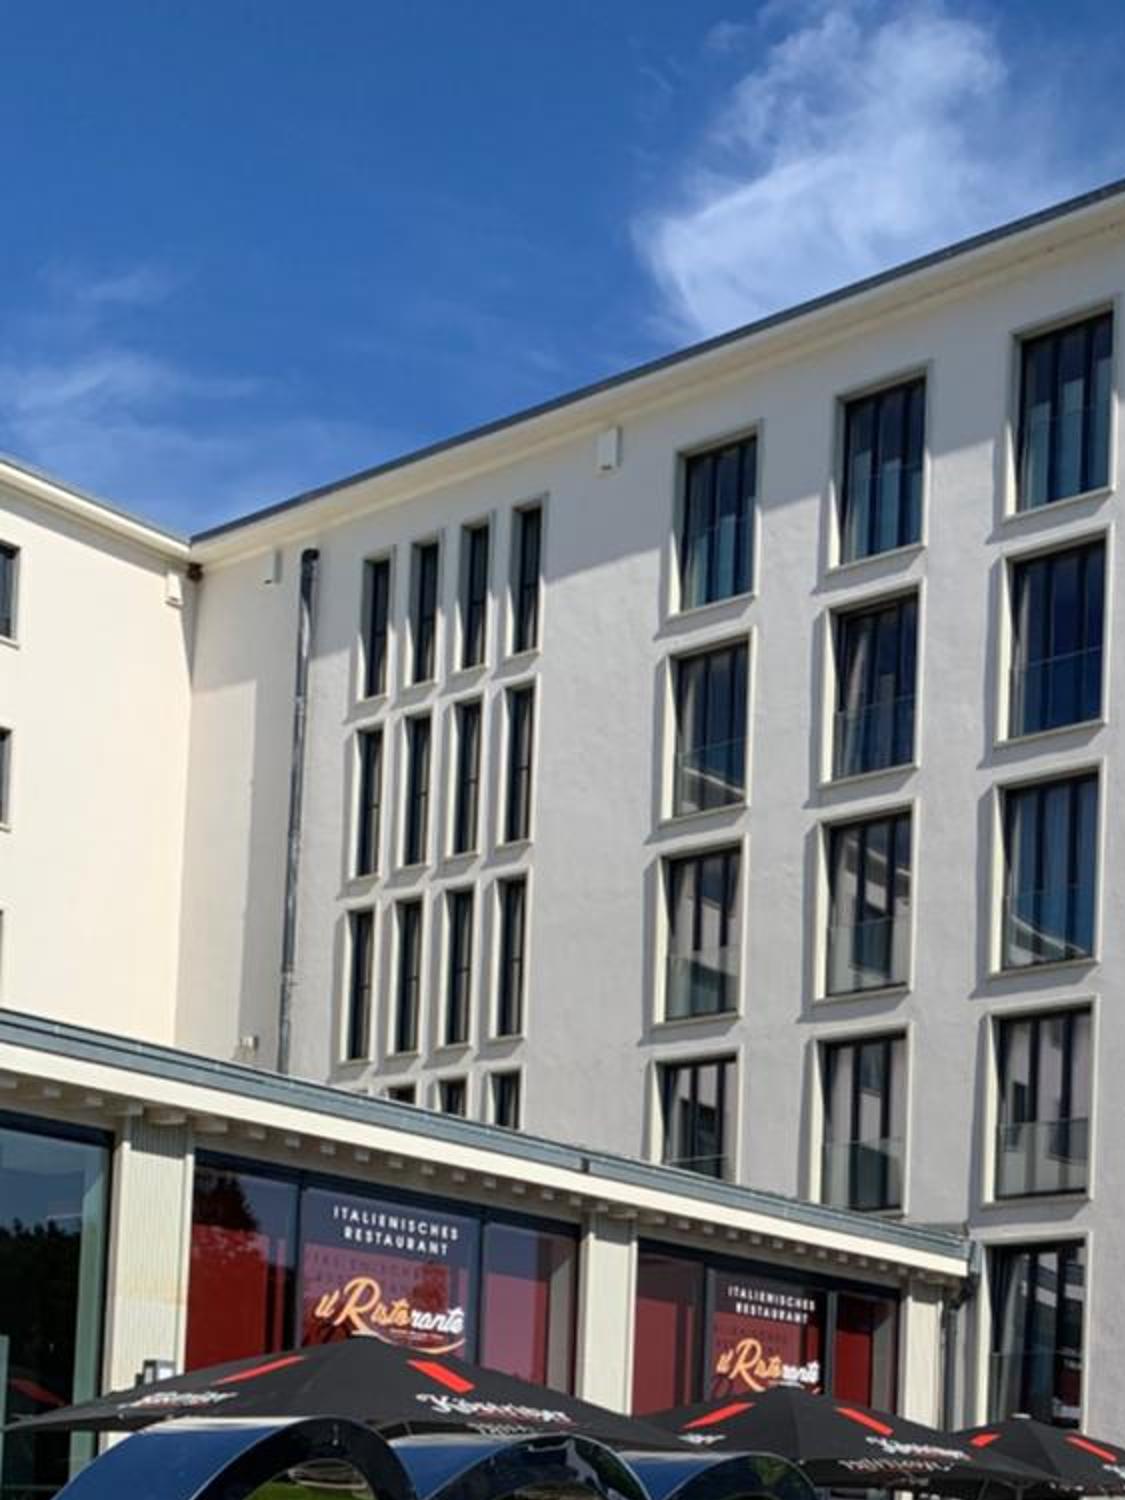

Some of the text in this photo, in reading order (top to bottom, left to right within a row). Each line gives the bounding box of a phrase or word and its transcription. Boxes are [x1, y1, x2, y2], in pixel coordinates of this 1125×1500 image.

[332, 1205, 459, 1241] ITALIENISCHES
[343, 1226, 449, 1256] RESTAURANT
[333, 1276, 465, 1337] Ristorante
